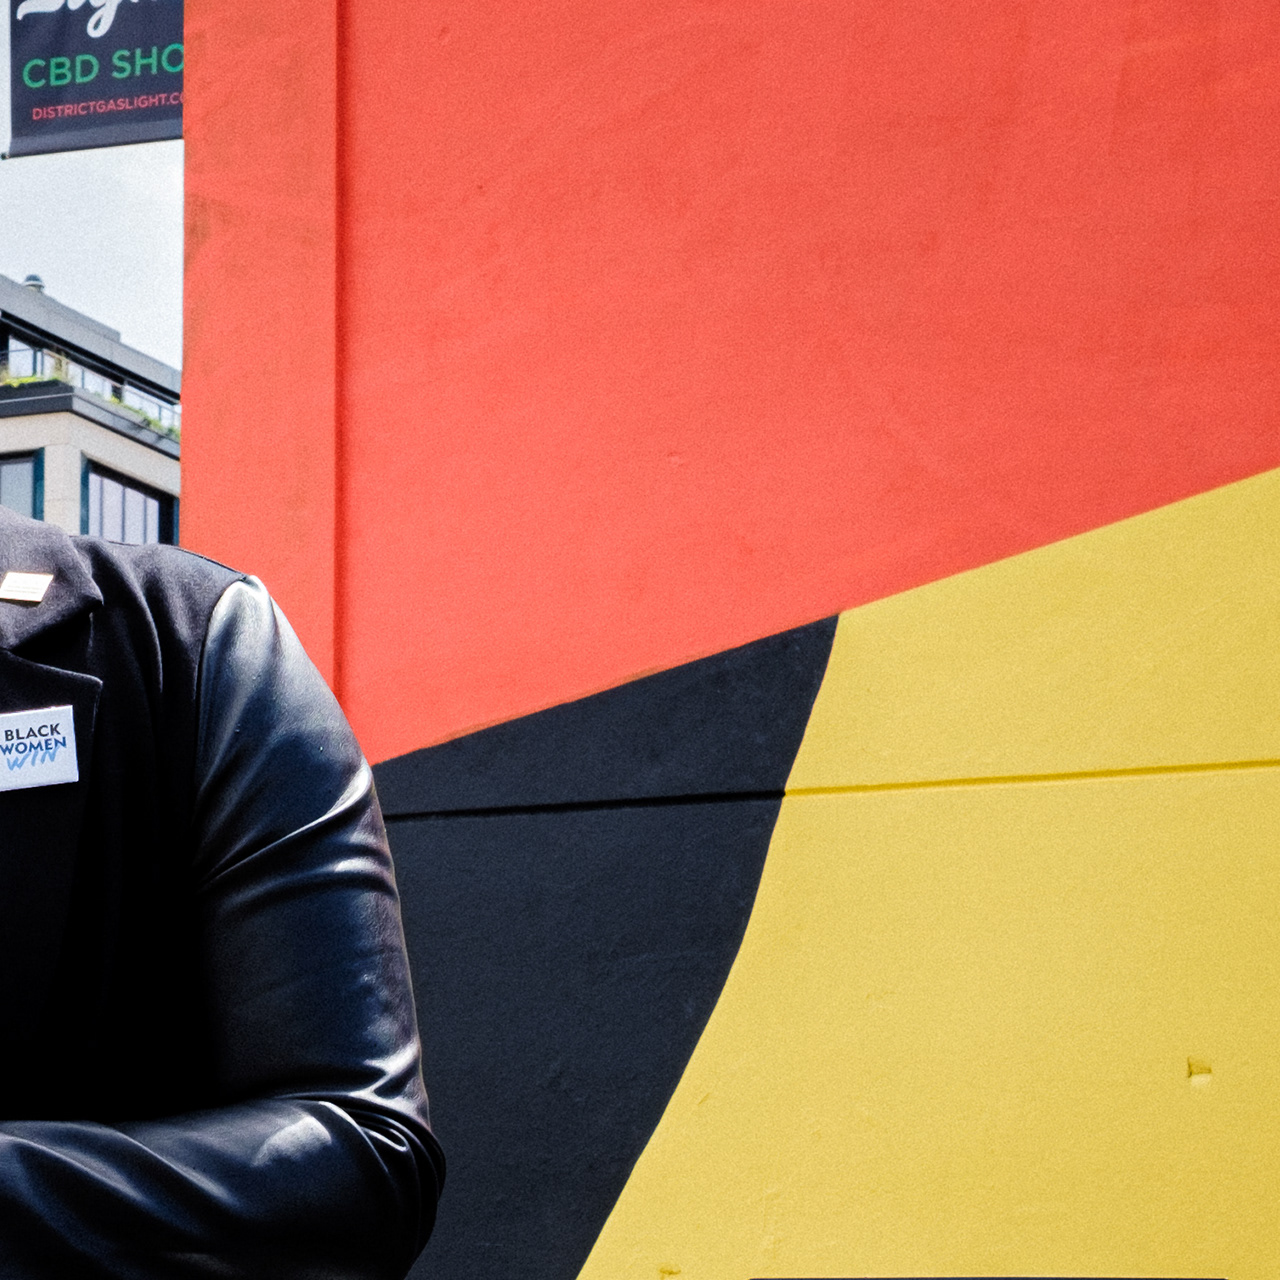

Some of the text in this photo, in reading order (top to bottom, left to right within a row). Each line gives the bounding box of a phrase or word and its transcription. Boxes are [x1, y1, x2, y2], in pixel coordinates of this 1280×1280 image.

[22, 54, 100, 88] CBD
[4, 723, 62, 742] BLACK
[0, 736, 67, 756] WOMEN
[6, 746, 58, 771] WIN
